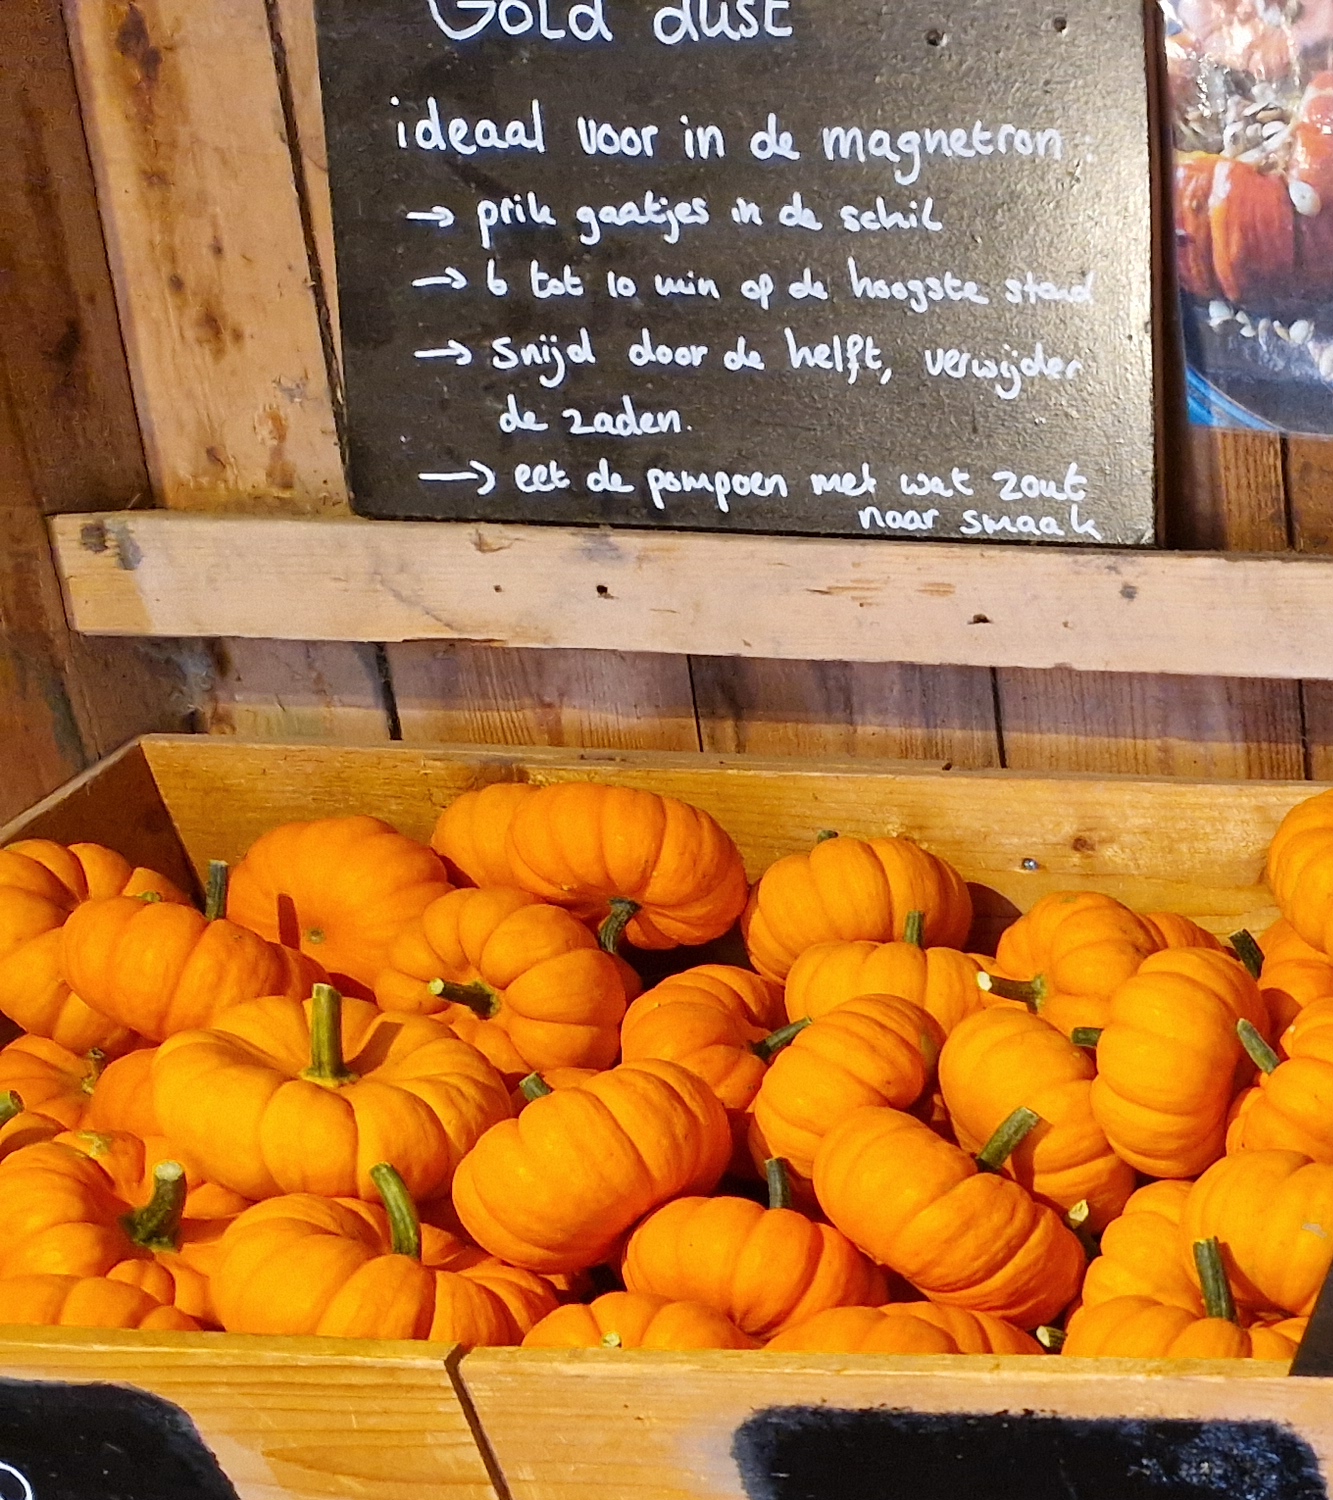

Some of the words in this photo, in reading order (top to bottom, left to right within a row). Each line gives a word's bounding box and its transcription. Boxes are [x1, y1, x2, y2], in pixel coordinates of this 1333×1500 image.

[390, 96, 547, 155] ideaal
[577, 116, 659, 158] voor
[680, 115, 725, 160] in
[750, 113, 801, 161] de
[576, 190, 709, 246] gaatjes
[731, 197, 763, 227] in
[778, 191, 824, 231] de
[840, 195, 943, 232] schil
[487, 258, 508, 296] 6
[530, 259, 583, 299] tot
[607, 271, 636, 298] 10
[654, 270, 720, 300] min
[740, 273, 774, 310] op
[788, 267, 829, 300] de
[848, 256, 990, 314] hoogste
[1005, 271, 1095, 305] stand
[629, 327, 708, 367] door
[723, 335, 765, 371] de
[924, 342, 1083, 400] verwijder
[500, 393, 549, 433] de
[514, 459, 571, 493] eet
[586, 457, 635, 492] de
[646, 468, 788, 513] pompoen
[810, 462, 877, 497] met
[900, 467, 974, 498] wat
[992, 462, 1088, 501] zout
[858, 506, 940, 531] naar
[959, 503, 1102, 541] smaak
